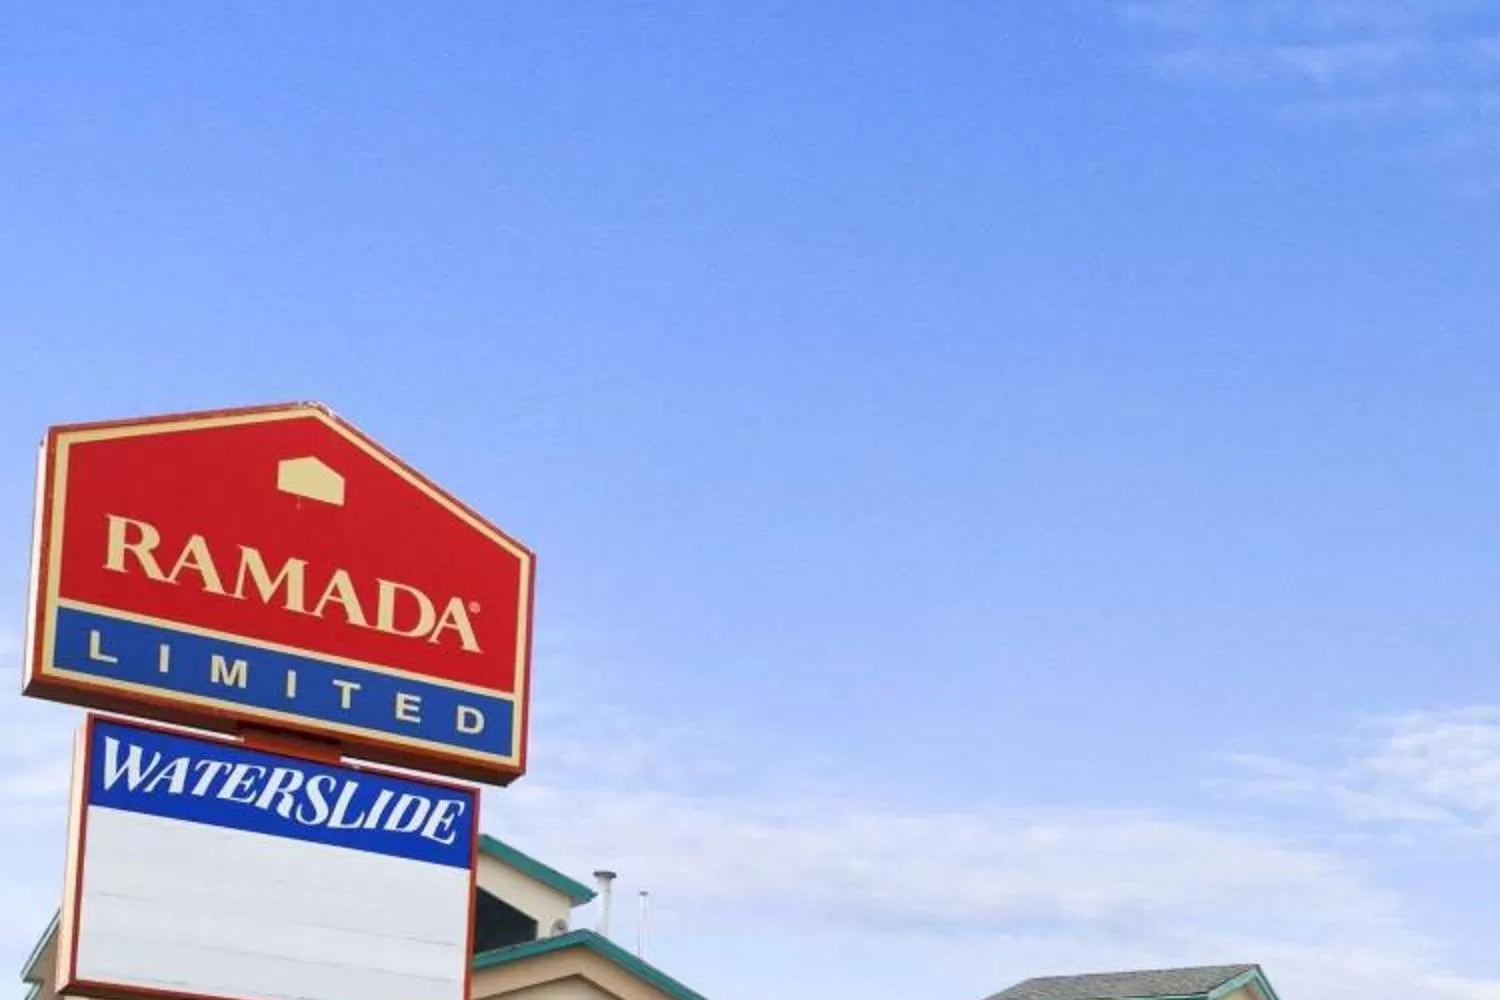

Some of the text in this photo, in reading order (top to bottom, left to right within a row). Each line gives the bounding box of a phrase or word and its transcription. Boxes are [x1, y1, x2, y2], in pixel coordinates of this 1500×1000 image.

[103, 513, 484, 653] RAMADA
[89, 629, 485, 735] LIMITED
[102, 735, 466, 846] WATERSLIDE
